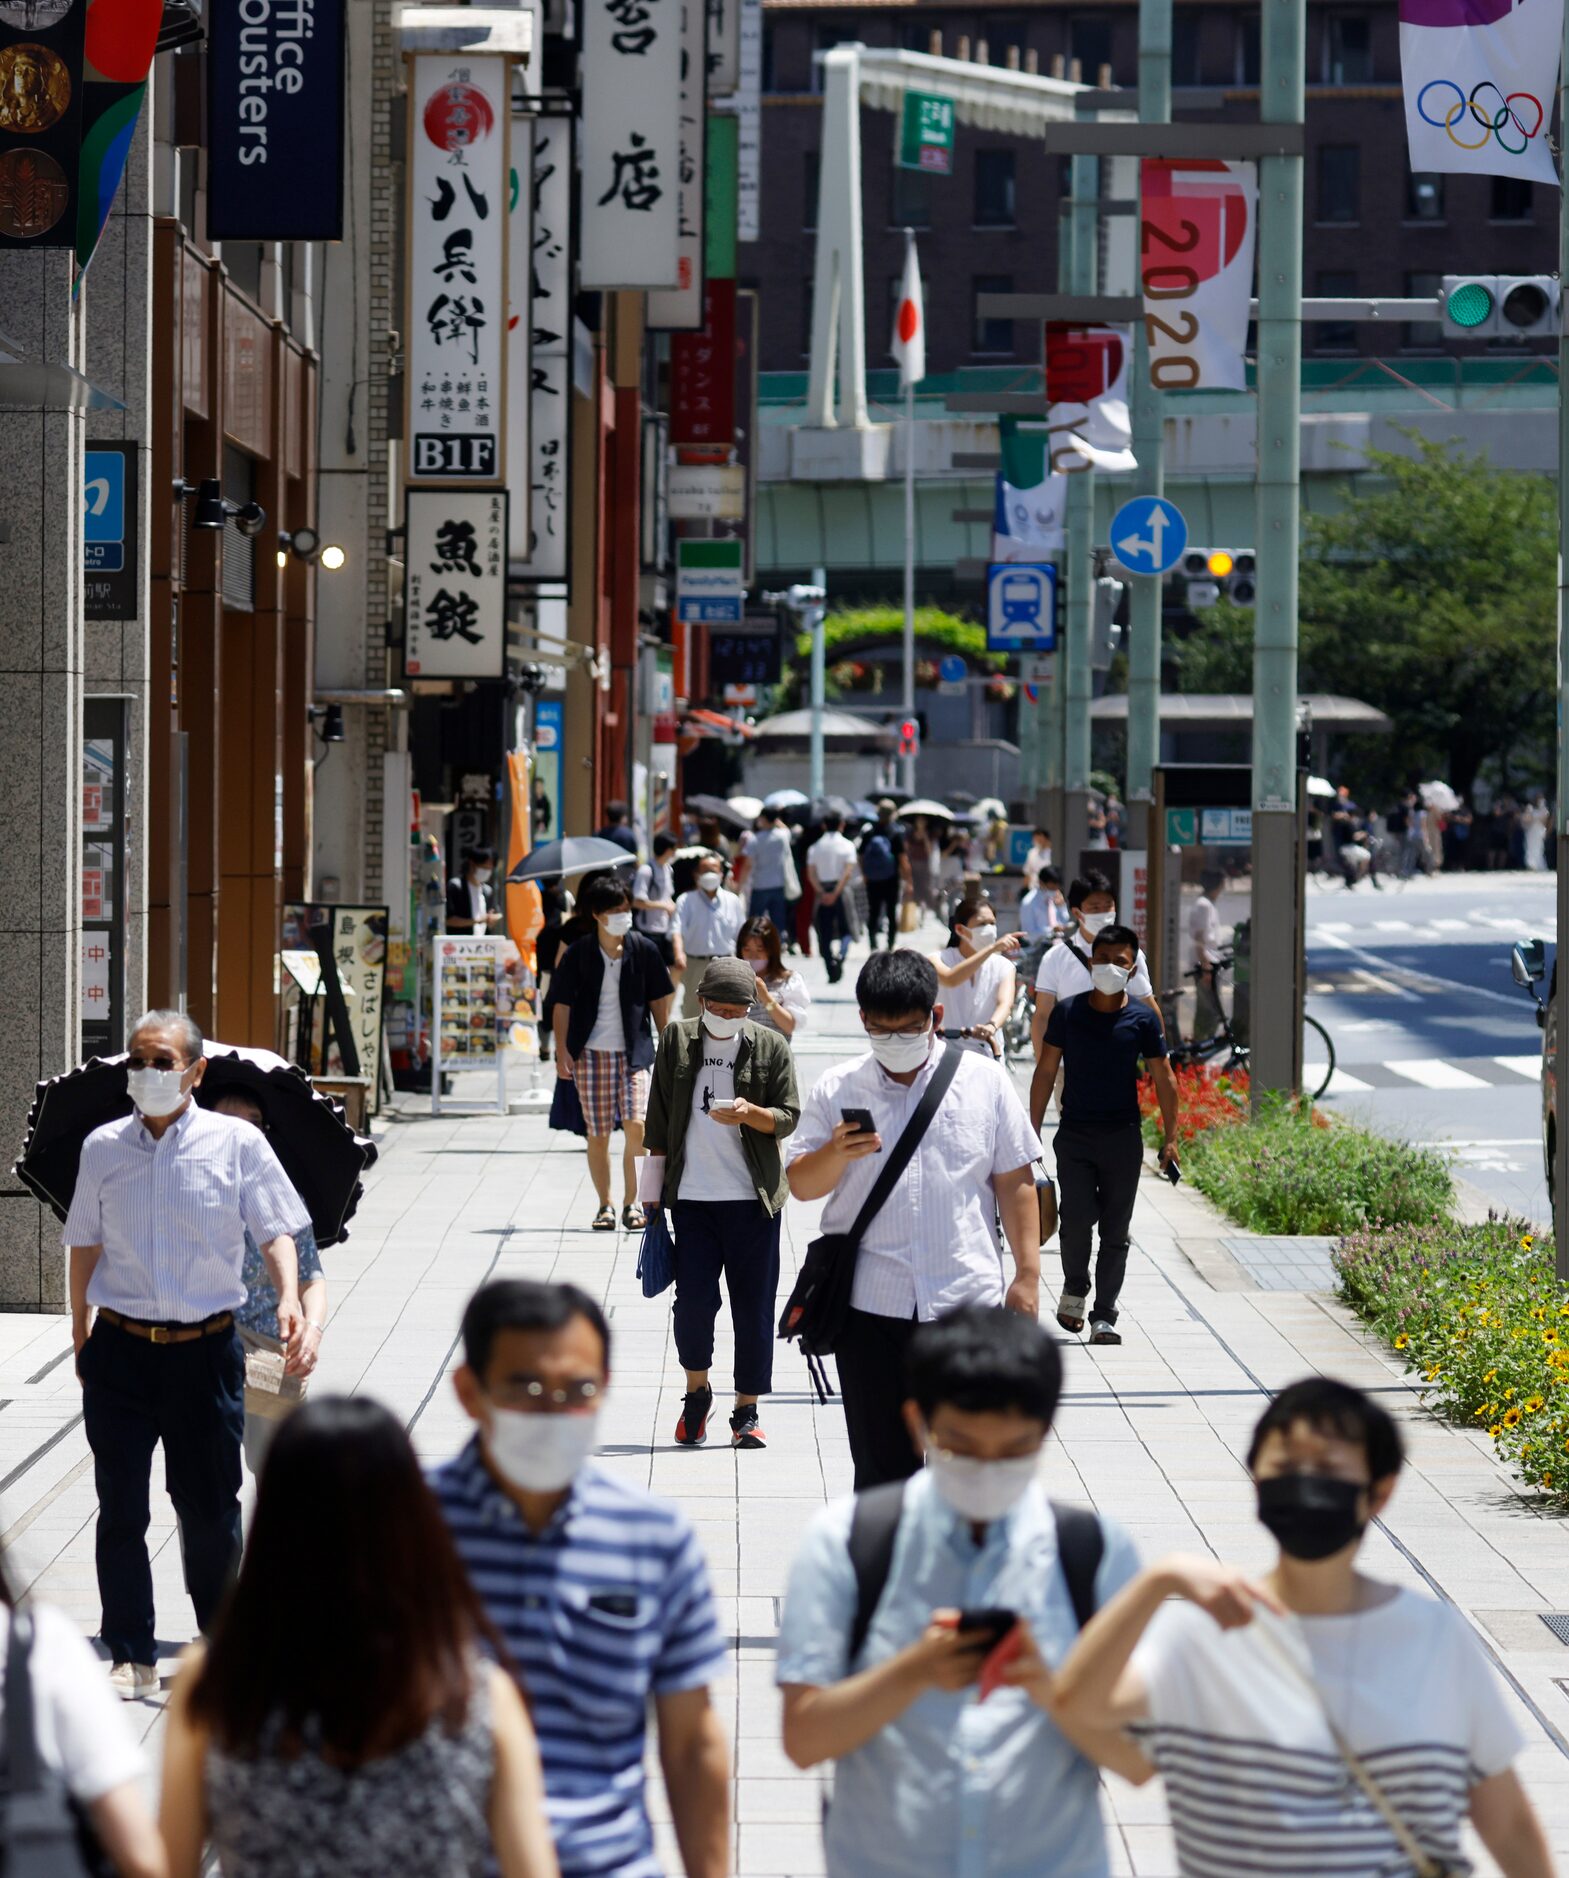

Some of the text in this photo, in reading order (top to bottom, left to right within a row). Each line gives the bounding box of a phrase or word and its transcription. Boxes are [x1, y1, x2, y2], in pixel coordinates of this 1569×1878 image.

[424, 171, 489, 366] 八兵衛
[1141, 220, 1200, 389] 2020
[416, 438, 494, 471] B1F
[82, 945, 105, 963] 中
[82, 985, 104, 1002] 中
